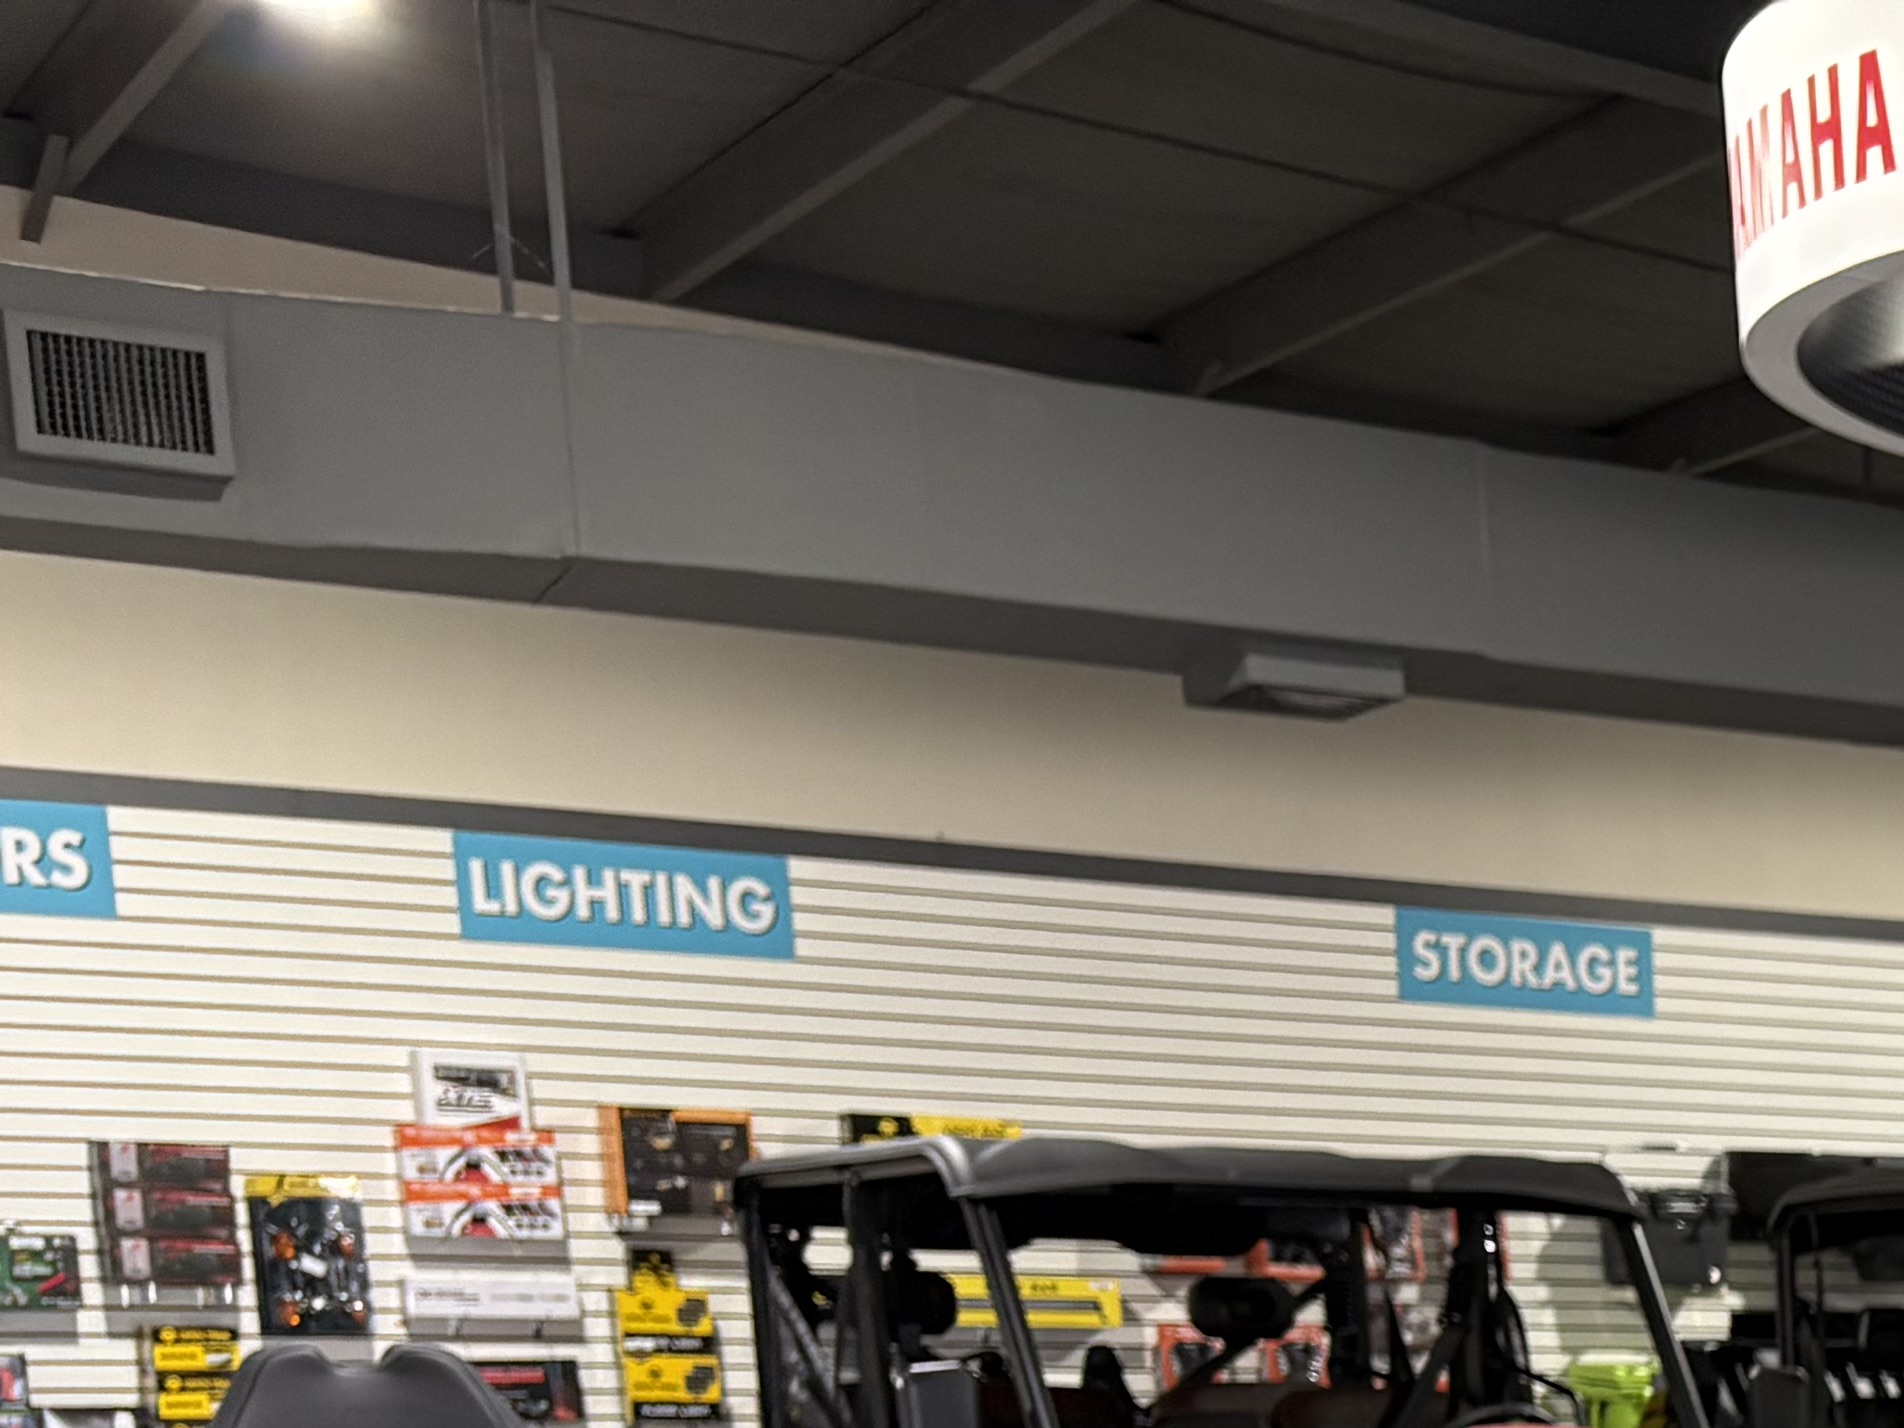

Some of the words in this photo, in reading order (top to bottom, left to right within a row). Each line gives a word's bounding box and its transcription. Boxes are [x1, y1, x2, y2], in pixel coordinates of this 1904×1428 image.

[1729, 48, 1897, 260] AMAHA
[468, 857, 780, 936] LIGHTING
[1411, 929, 1643, 997] STORAGE
